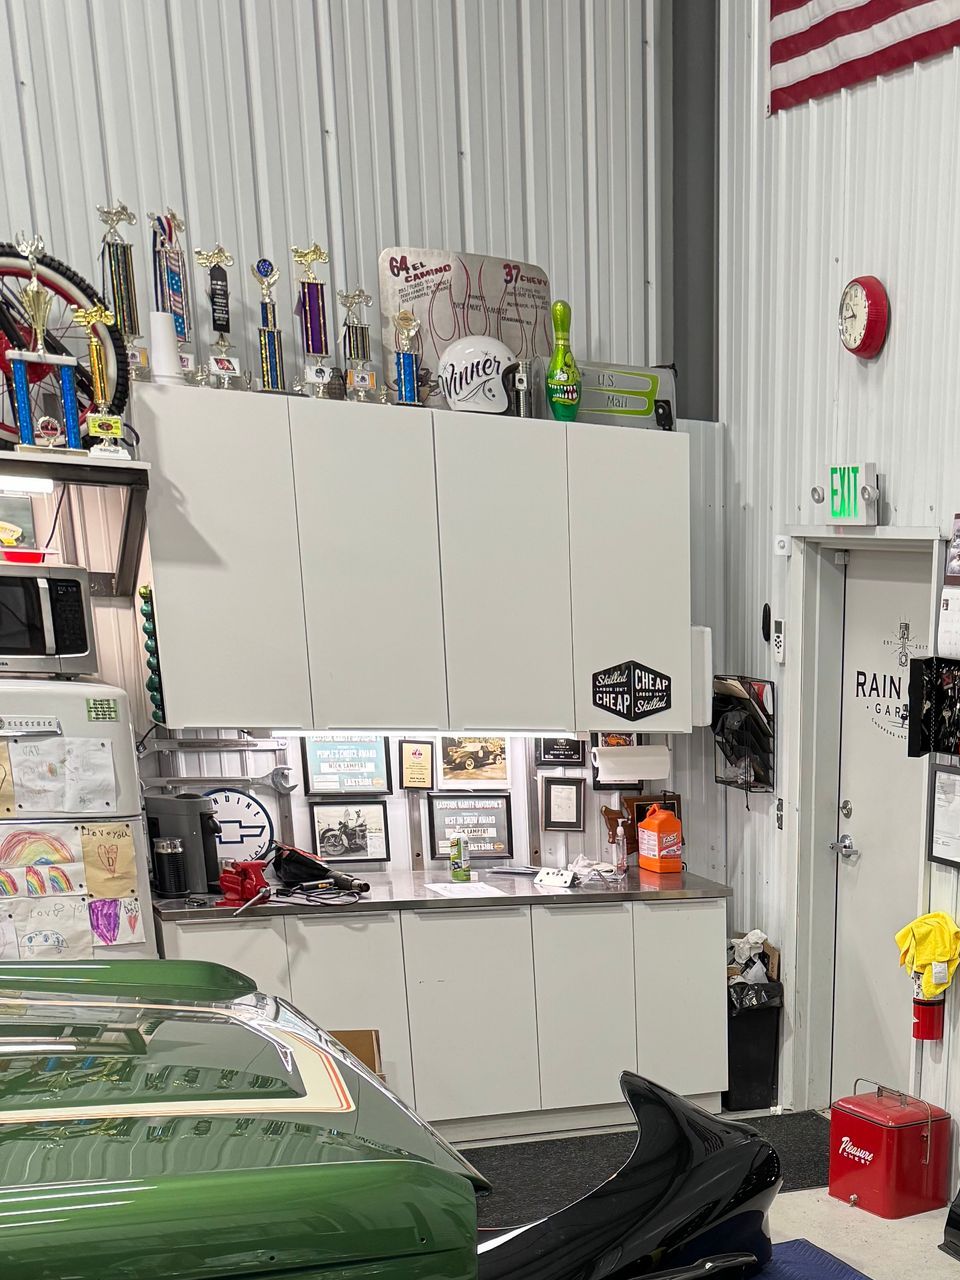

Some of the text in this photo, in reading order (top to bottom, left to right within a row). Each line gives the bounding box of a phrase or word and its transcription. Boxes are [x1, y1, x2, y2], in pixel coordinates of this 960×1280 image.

[389, 255, 427, 278] 64 EL
[404, 264, 452, 284] CAMINO
[503, 263, 549, 287] 37 CHEVY
[438, 355, 501, 401] Winner
[597, 374, 617, 388] U.S.
[607, 395, 628, 409] Mail
[830, 466, 860, 519] EXIT
[596, 670, 628, 686] Skilled
[635, 668, 669, 690] CHEAP
[856, 670, 902, 700] RAIN
[596, 693, 631, 714] CHEAP
[635, 696, 667, 713] Skilled
[212, 794, 261, 817] NUINE
[839, 1136, 874, 1161] Pleasure
[843, 1151, 870, 1166] CHEST
